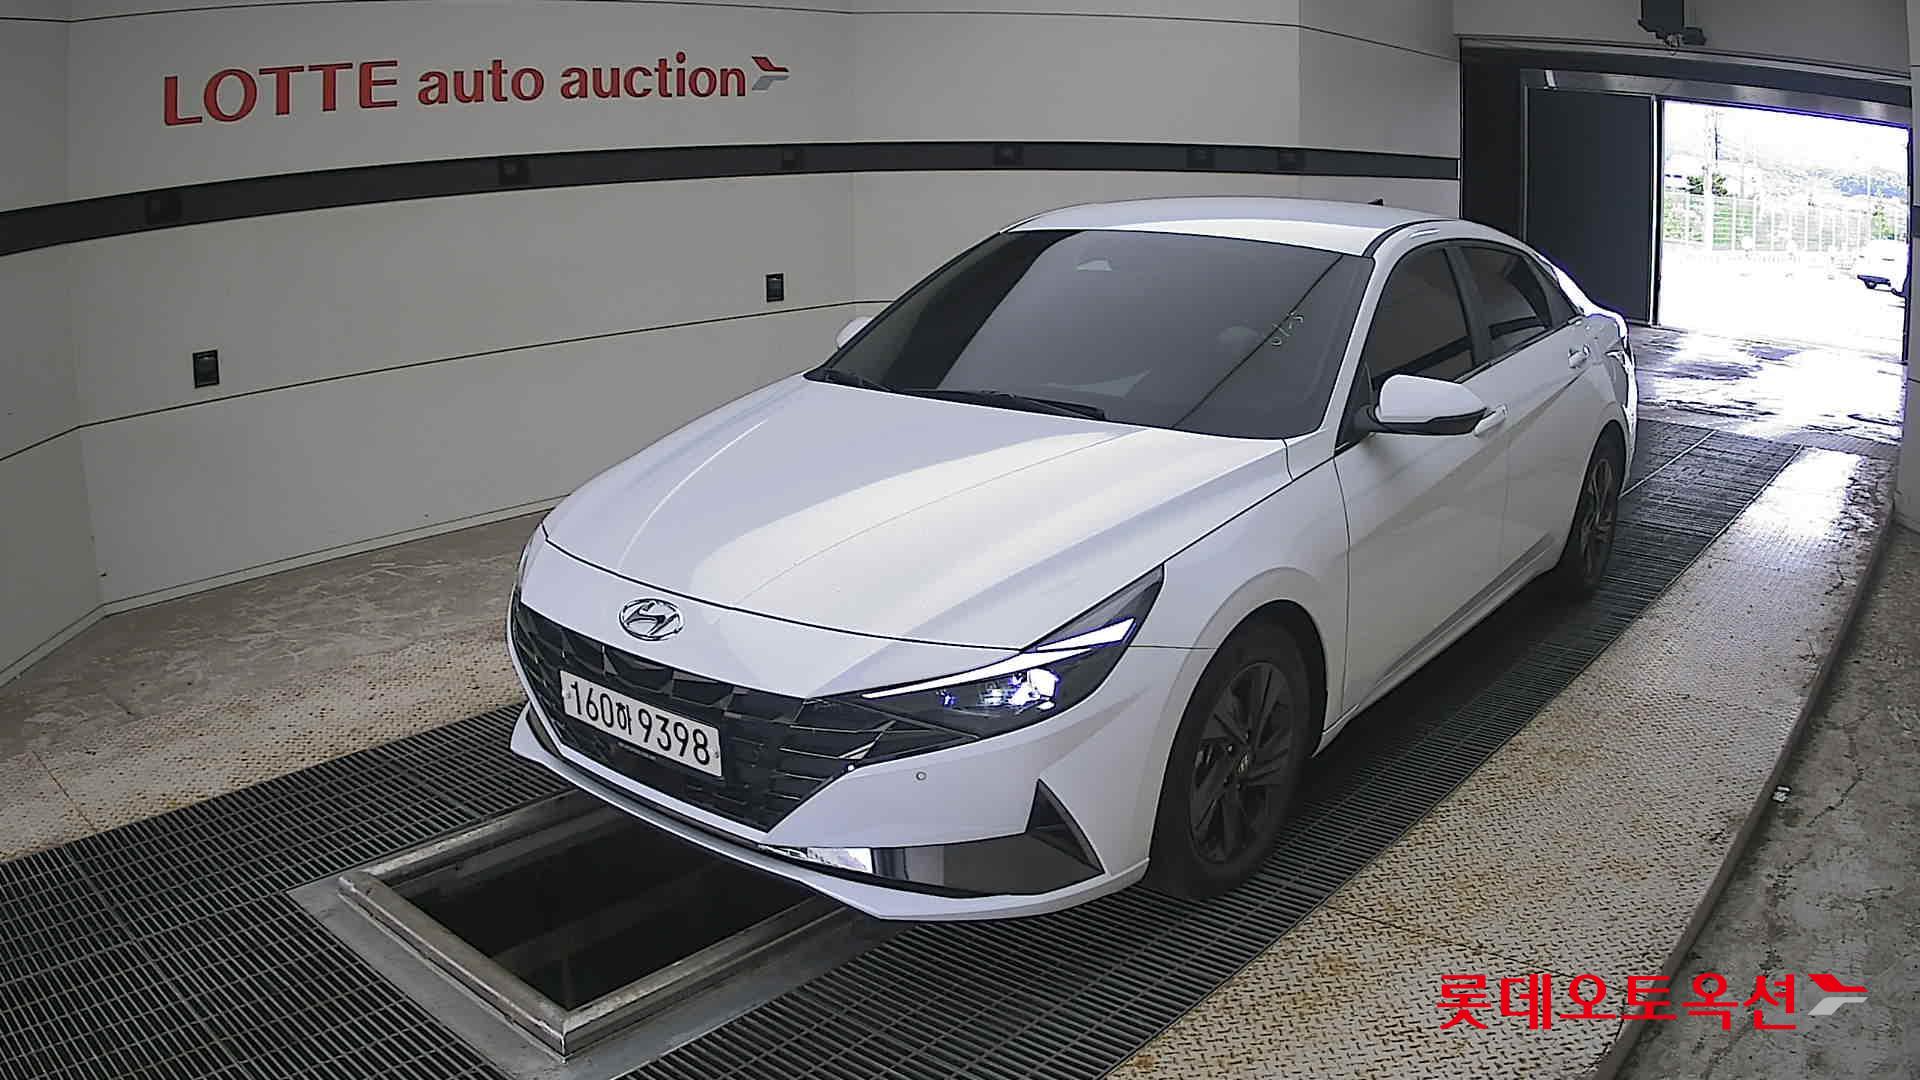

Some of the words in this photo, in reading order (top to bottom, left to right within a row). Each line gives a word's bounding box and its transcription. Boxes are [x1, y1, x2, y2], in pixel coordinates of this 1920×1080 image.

[164, 61, 398, 126] LOTTE
[418, 58, 545, 105] auto
[560, 51, 747, 99] auction
